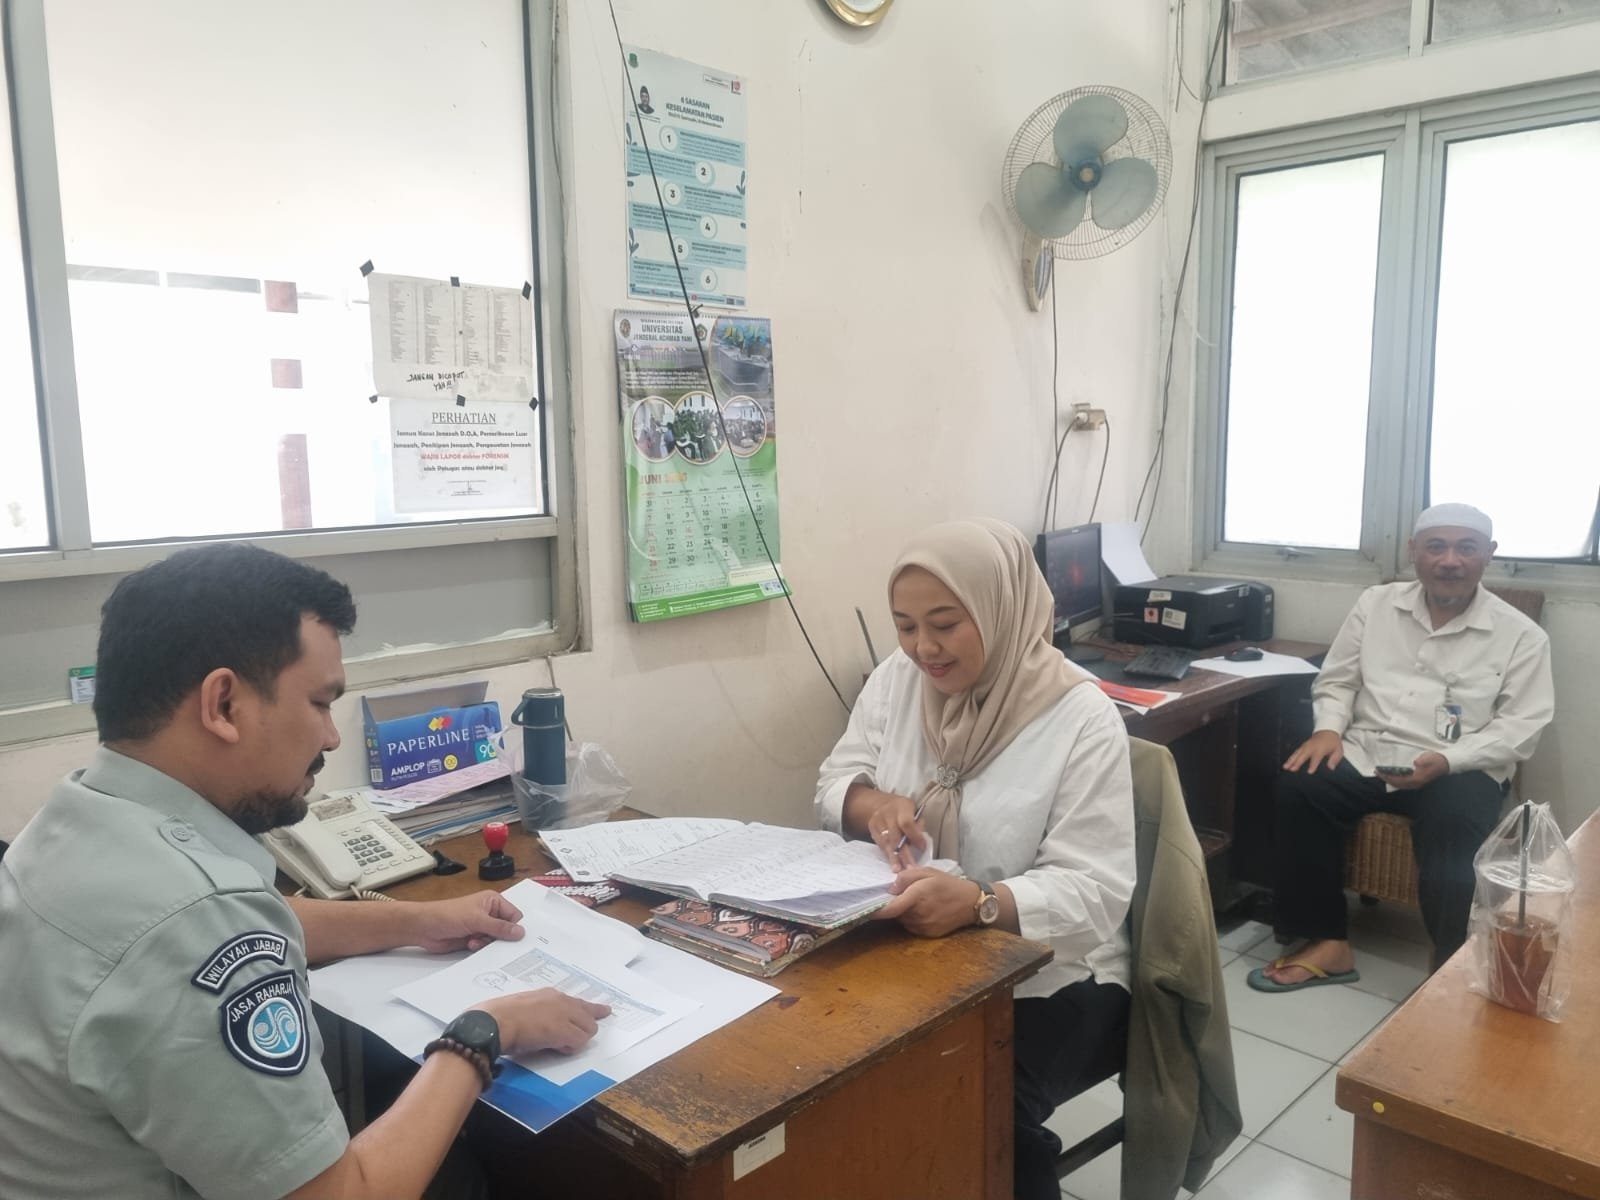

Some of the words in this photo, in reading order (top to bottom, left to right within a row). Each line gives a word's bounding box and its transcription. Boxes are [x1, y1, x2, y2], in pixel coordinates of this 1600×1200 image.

[667, 135, 672, 143] 1
[701, 167, 707, 176] 2
[670, 189, 676, 198] 3
[704, 223, 711, 231] 4
[677, 245, 683, 253] 5
[705, 276, 711, 284] 6
[641, 324, 683, 335] UNIVERSITAS
[431, 412, 497, 425] PERHATIAN
[387, 728, 471, 756] PAPERLINE
[391, 762, 425, 777] AMPLOP
[206, 942, 250, 982] WILAYAH
[253, 940, 282, 953] JABAR
[230, 997, 256, 1023] JASA
